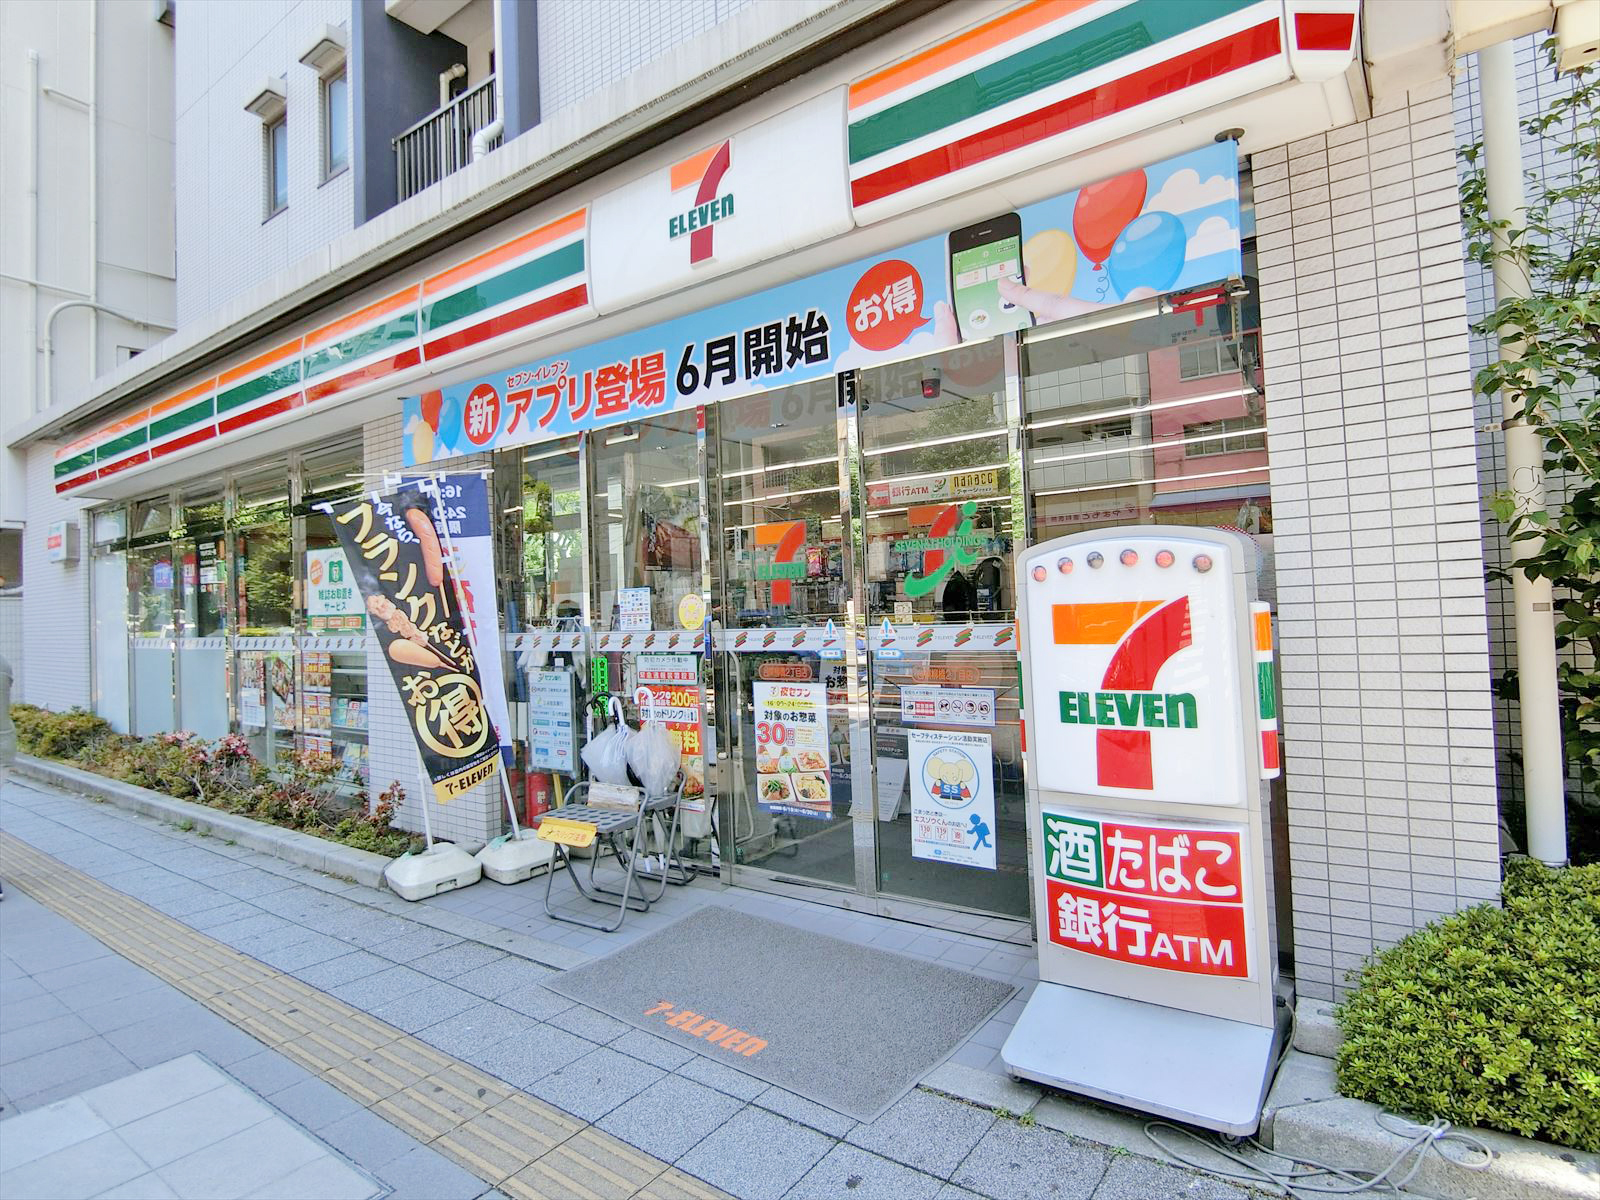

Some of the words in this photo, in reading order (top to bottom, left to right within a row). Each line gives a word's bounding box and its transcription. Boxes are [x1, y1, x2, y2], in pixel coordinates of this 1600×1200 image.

[853, 274, 917, 333] お得
[469, 392, 495, 437] 新
[507, 352, 666, 435] アプリ登場
[676, 310, 829, 396] 6月開始
[336, 502, 436, 631] フランク
[324, 602, 347, 612] サービス
[428, 621, 474, 674] などが
[1046, 818, 1097, 882] 酒
[1106, 829, 1237, 896] たばこ
[1057, 892, 1233, 966] 銀行ATM
